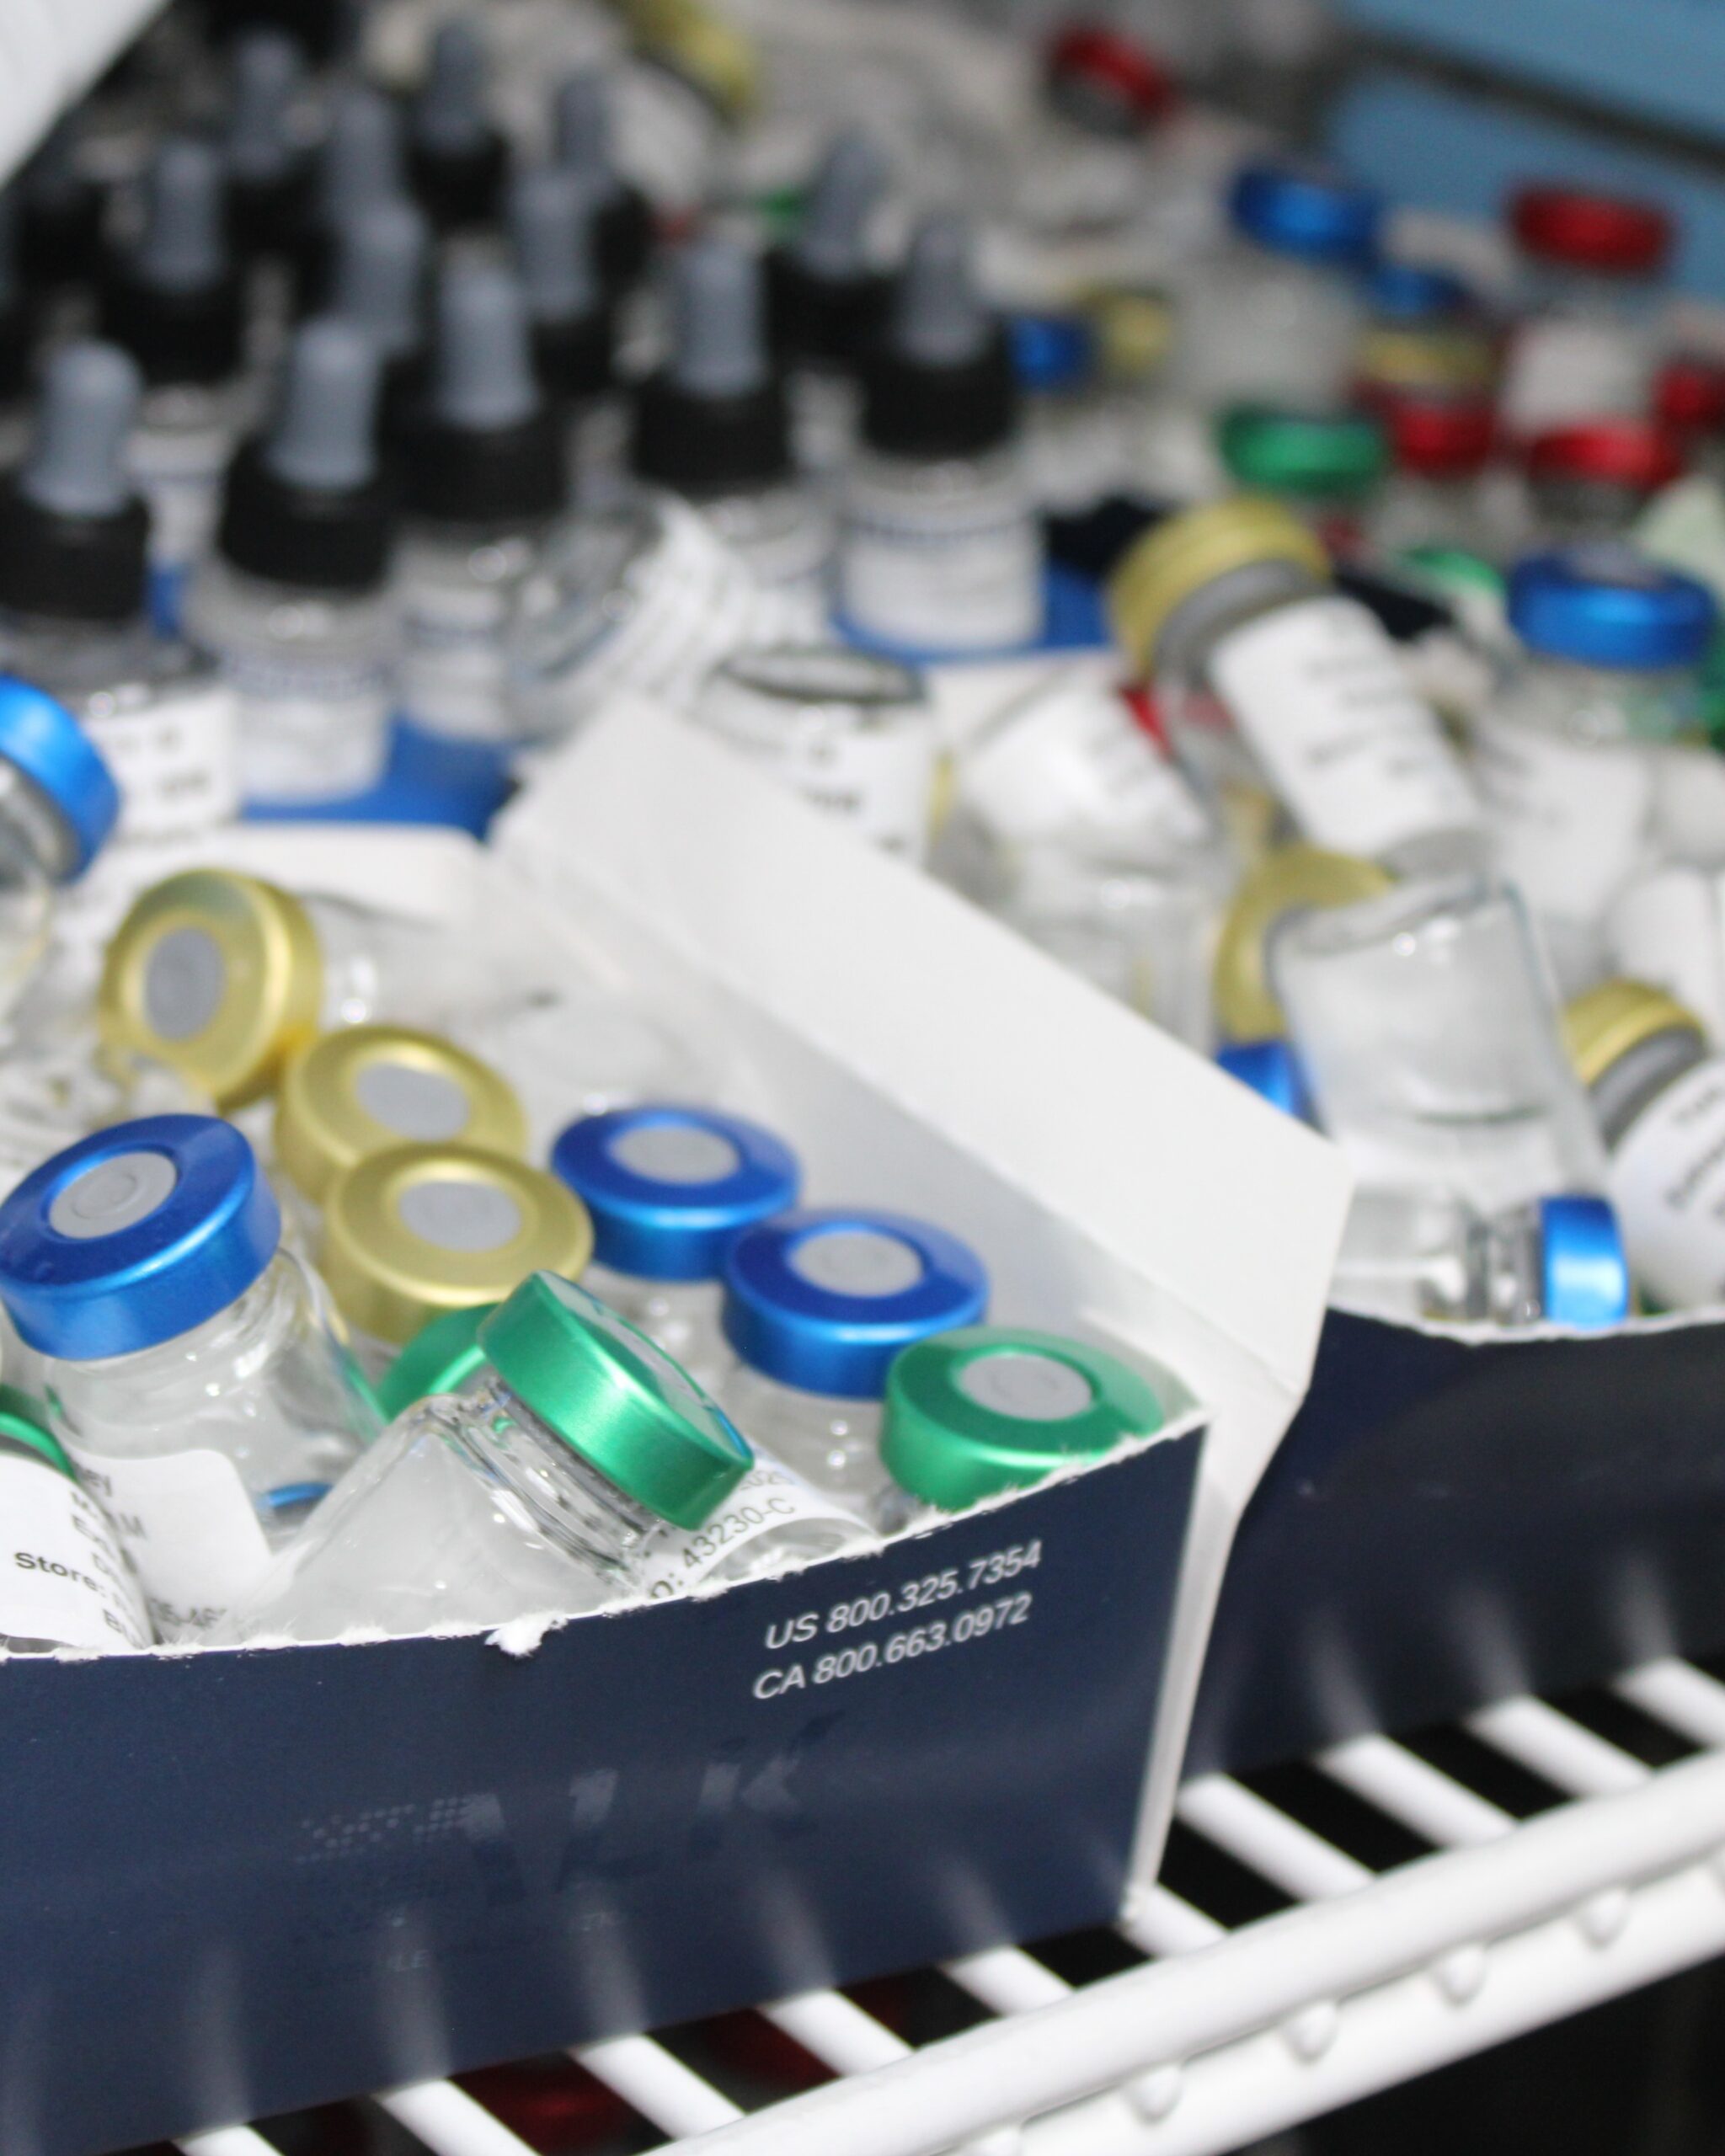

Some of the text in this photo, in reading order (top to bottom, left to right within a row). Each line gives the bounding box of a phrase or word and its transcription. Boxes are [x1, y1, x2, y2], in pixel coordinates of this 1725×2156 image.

[14, 1551, 107, 1598] Store:
[682, 1497, 795, 1568] 43230-C
[765, 1539, 1042, 1649] US 800.325.7354
[753, 1592, 1033, 1700] CA 800.663.0972
